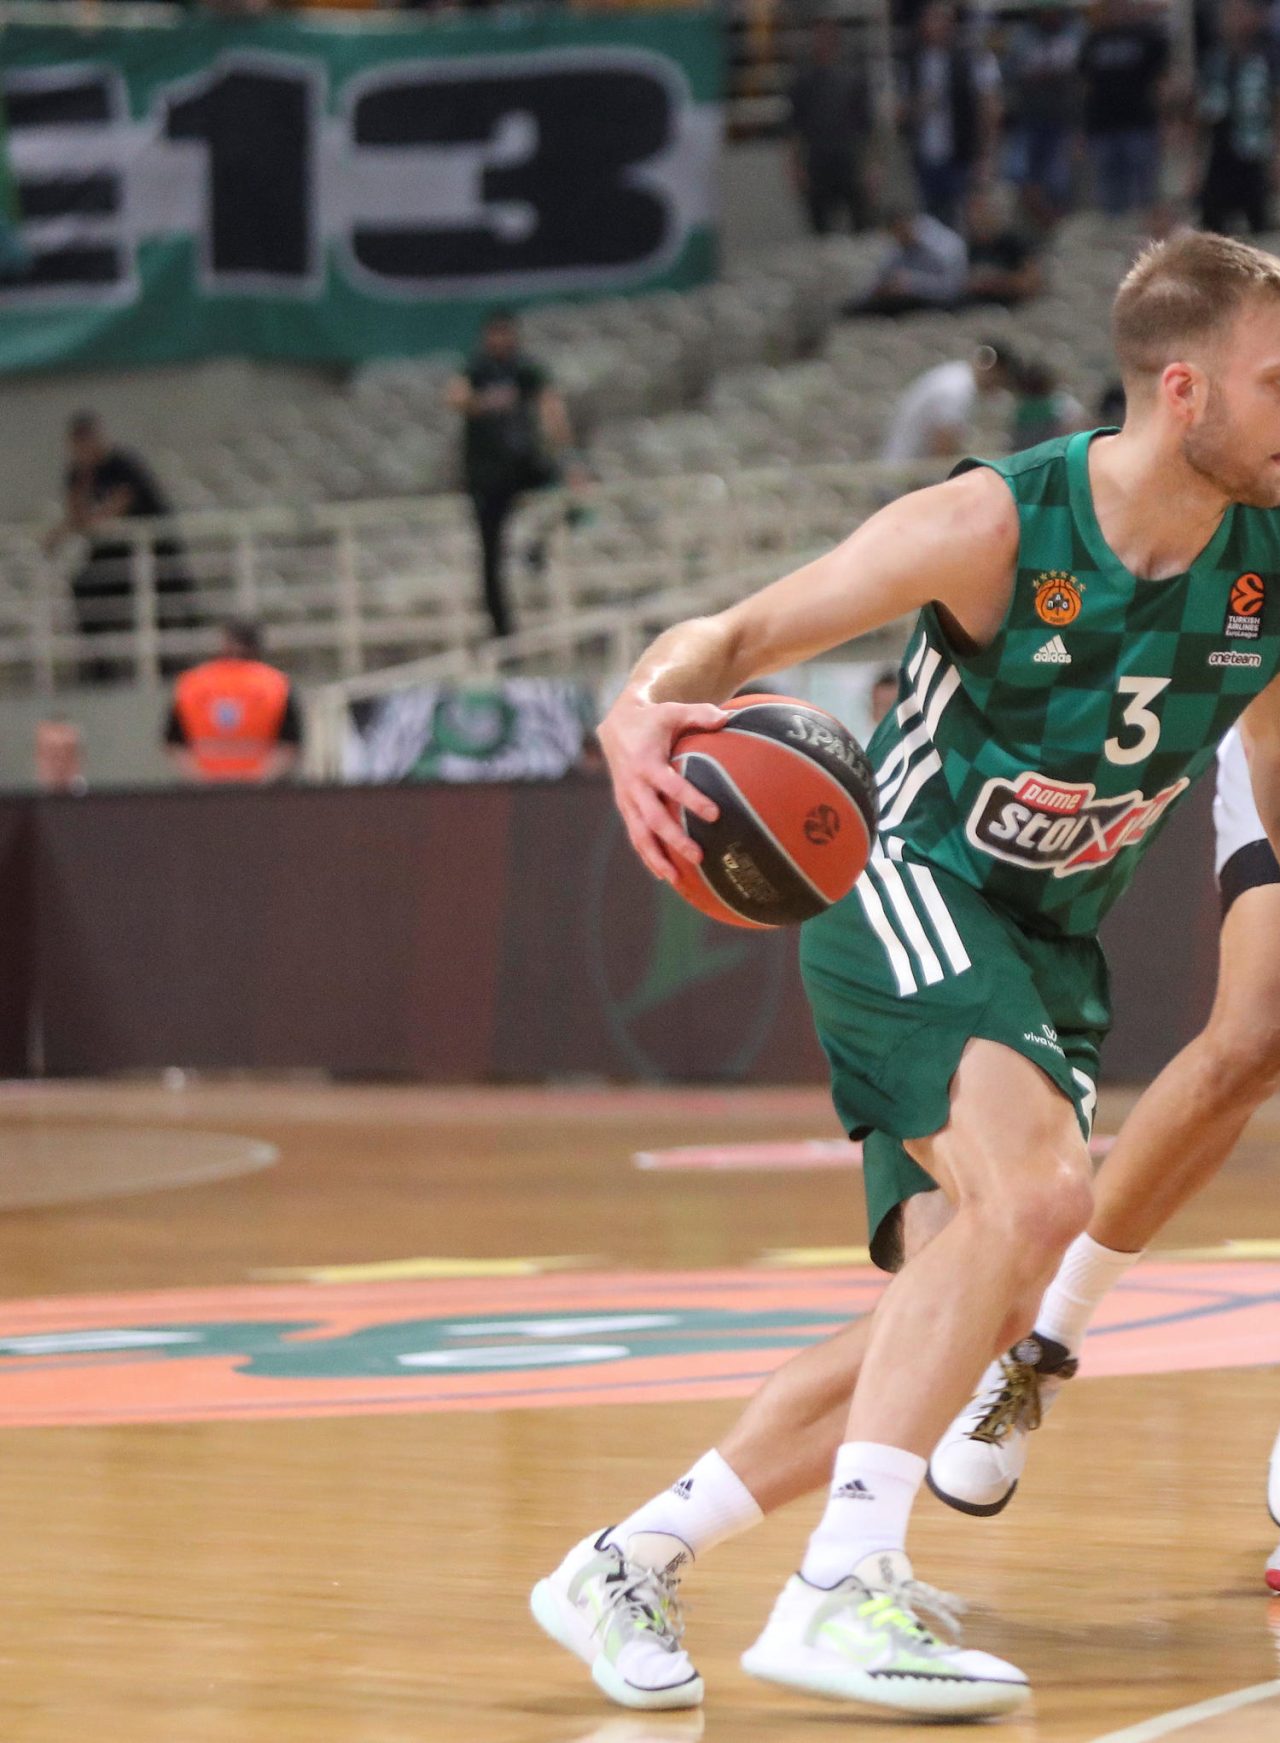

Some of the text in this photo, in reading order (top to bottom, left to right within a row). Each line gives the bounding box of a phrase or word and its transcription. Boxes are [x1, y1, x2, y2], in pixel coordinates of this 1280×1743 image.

[1226, 623, 1259, 632] AIRLINES
[1033, 651, 1072, 664] adidas
[1209, 652, 1261, 667] oneteam
[1104, 676, 1172, 766] 3
[1022, 783, 1082, 810] pame
